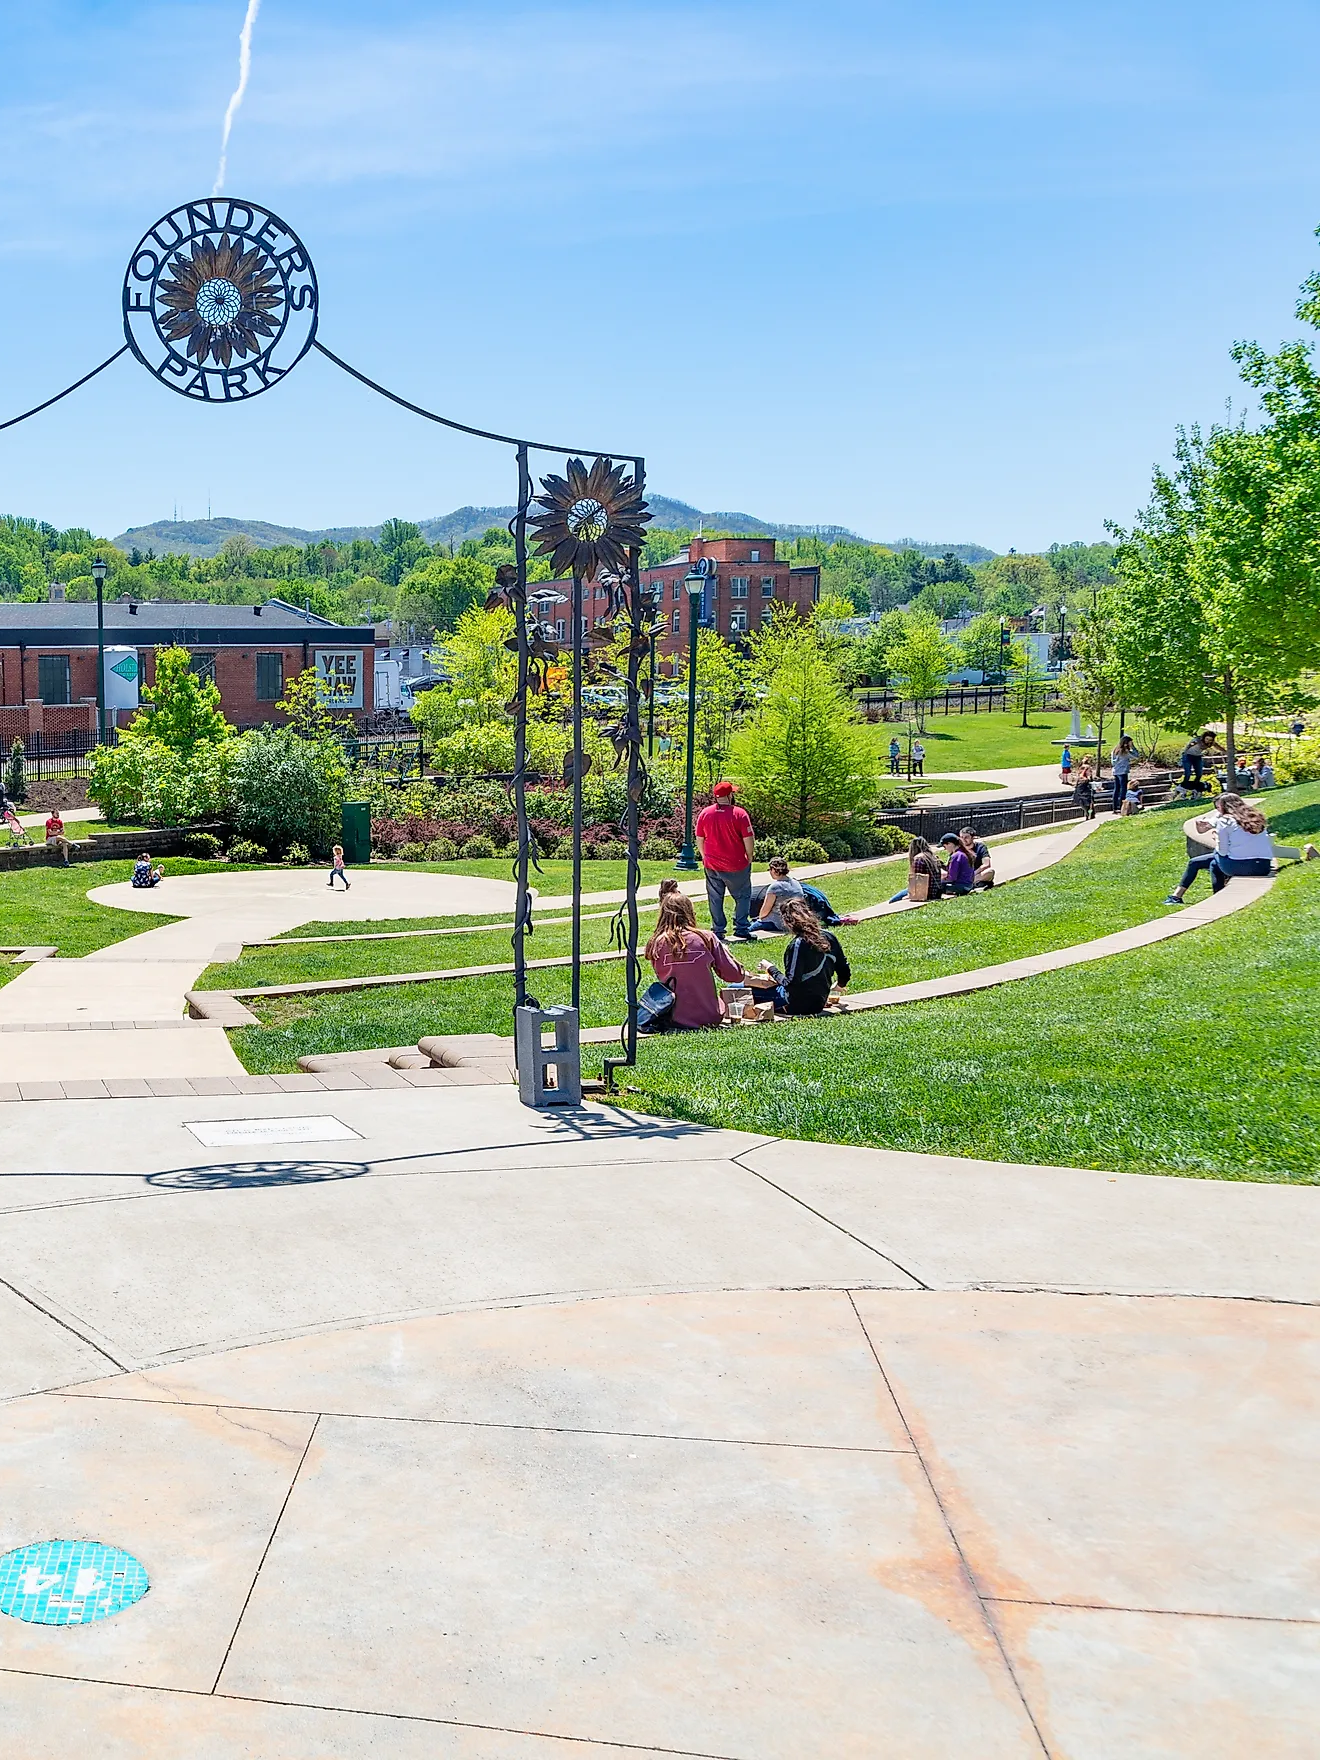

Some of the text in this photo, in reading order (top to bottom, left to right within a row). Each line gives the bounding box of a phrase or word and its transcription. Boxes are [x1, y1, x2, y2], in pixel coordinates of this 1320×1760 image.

[126, 201, 314, 312] FOUNDERS
[156, 350, 286, 400] PARK
[116, 663, 138, 673] HOLST
[321, 655, 356, 674] YEE
